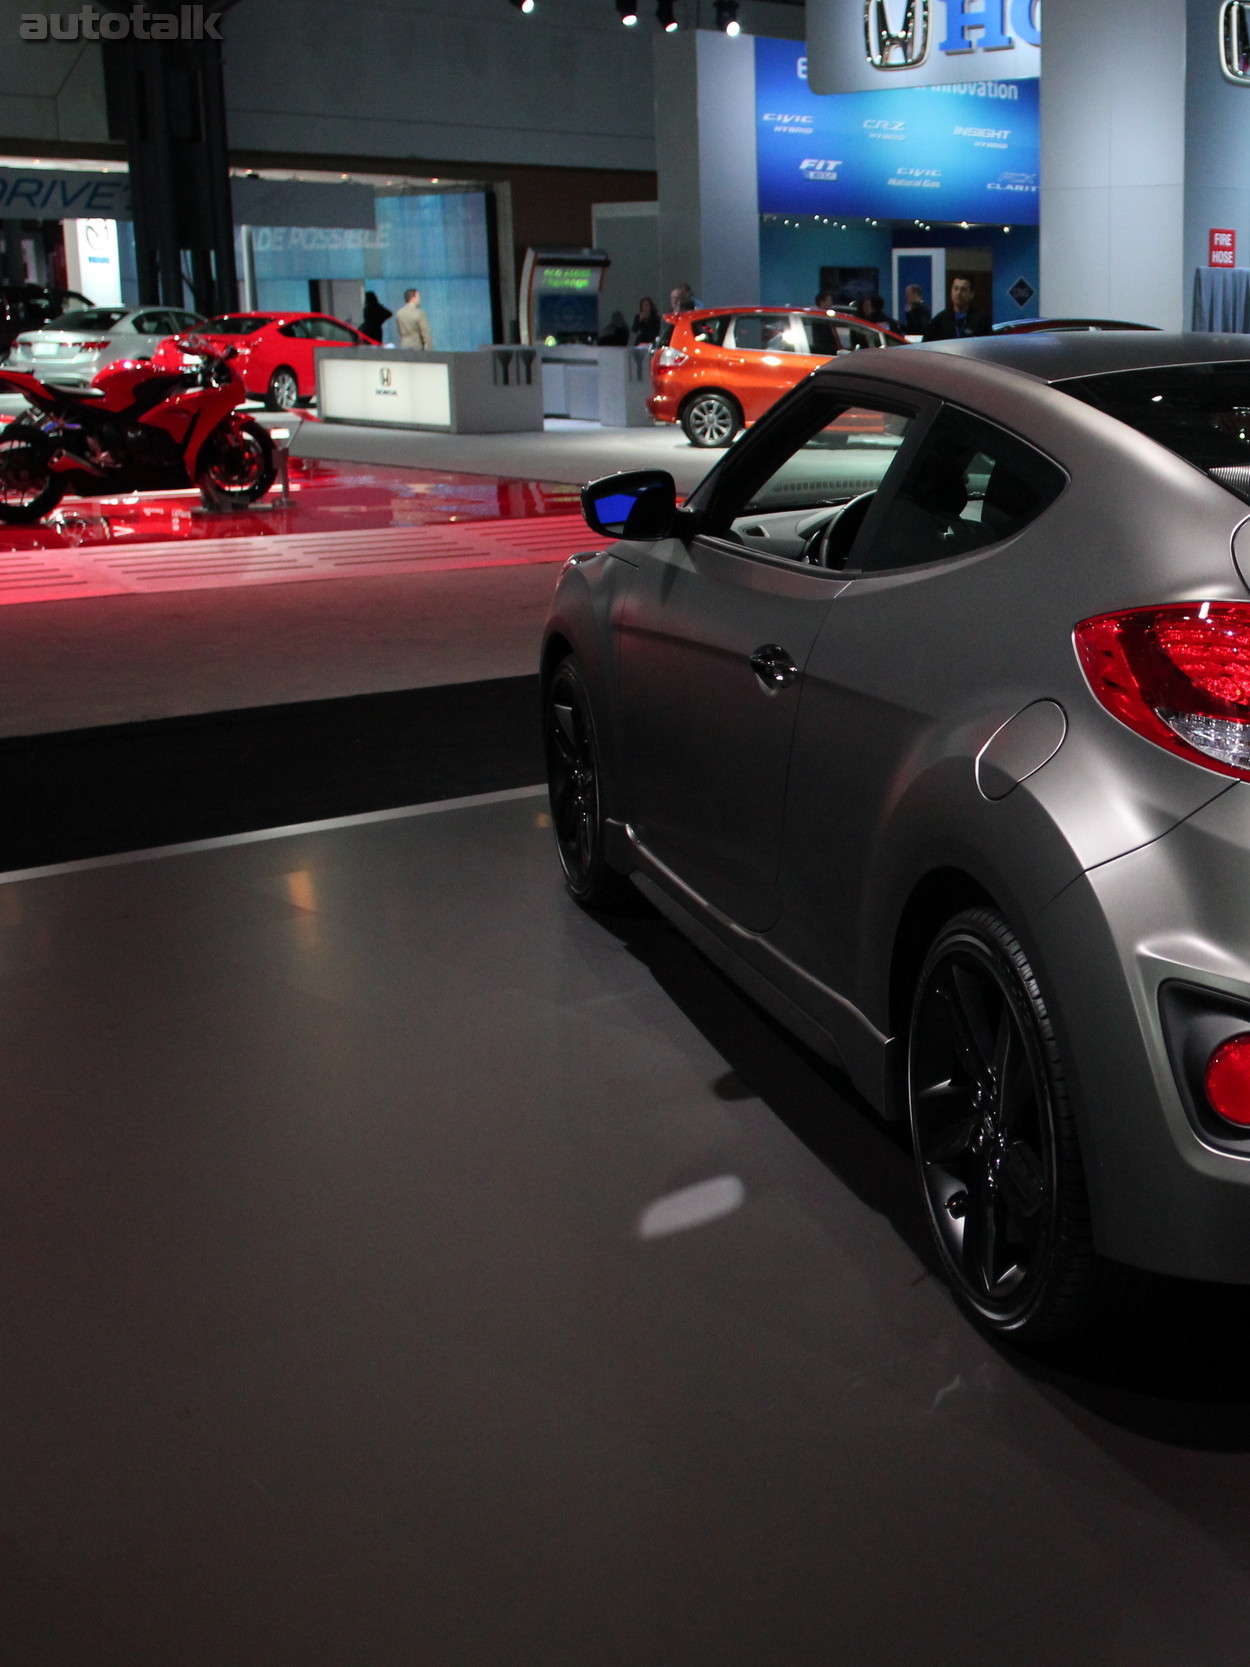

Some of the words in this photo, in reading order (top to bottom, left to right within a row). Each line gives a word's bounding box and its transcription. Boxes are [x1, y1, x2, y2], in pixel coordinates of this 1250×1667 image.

[939, 0, 1041, 51] H
[762, 113, 815, 124] CIVIC
[953, 126, 1012, 140] INSIGHT
[799, 158, 843, 171] FIT
[896, 167, 943, 177] CIVIC
[986, 182, 1040, 192] CLARIT
[1214, 232, 1232, 246] FIRE
[1212, 250, 1234, 264] HOSE
